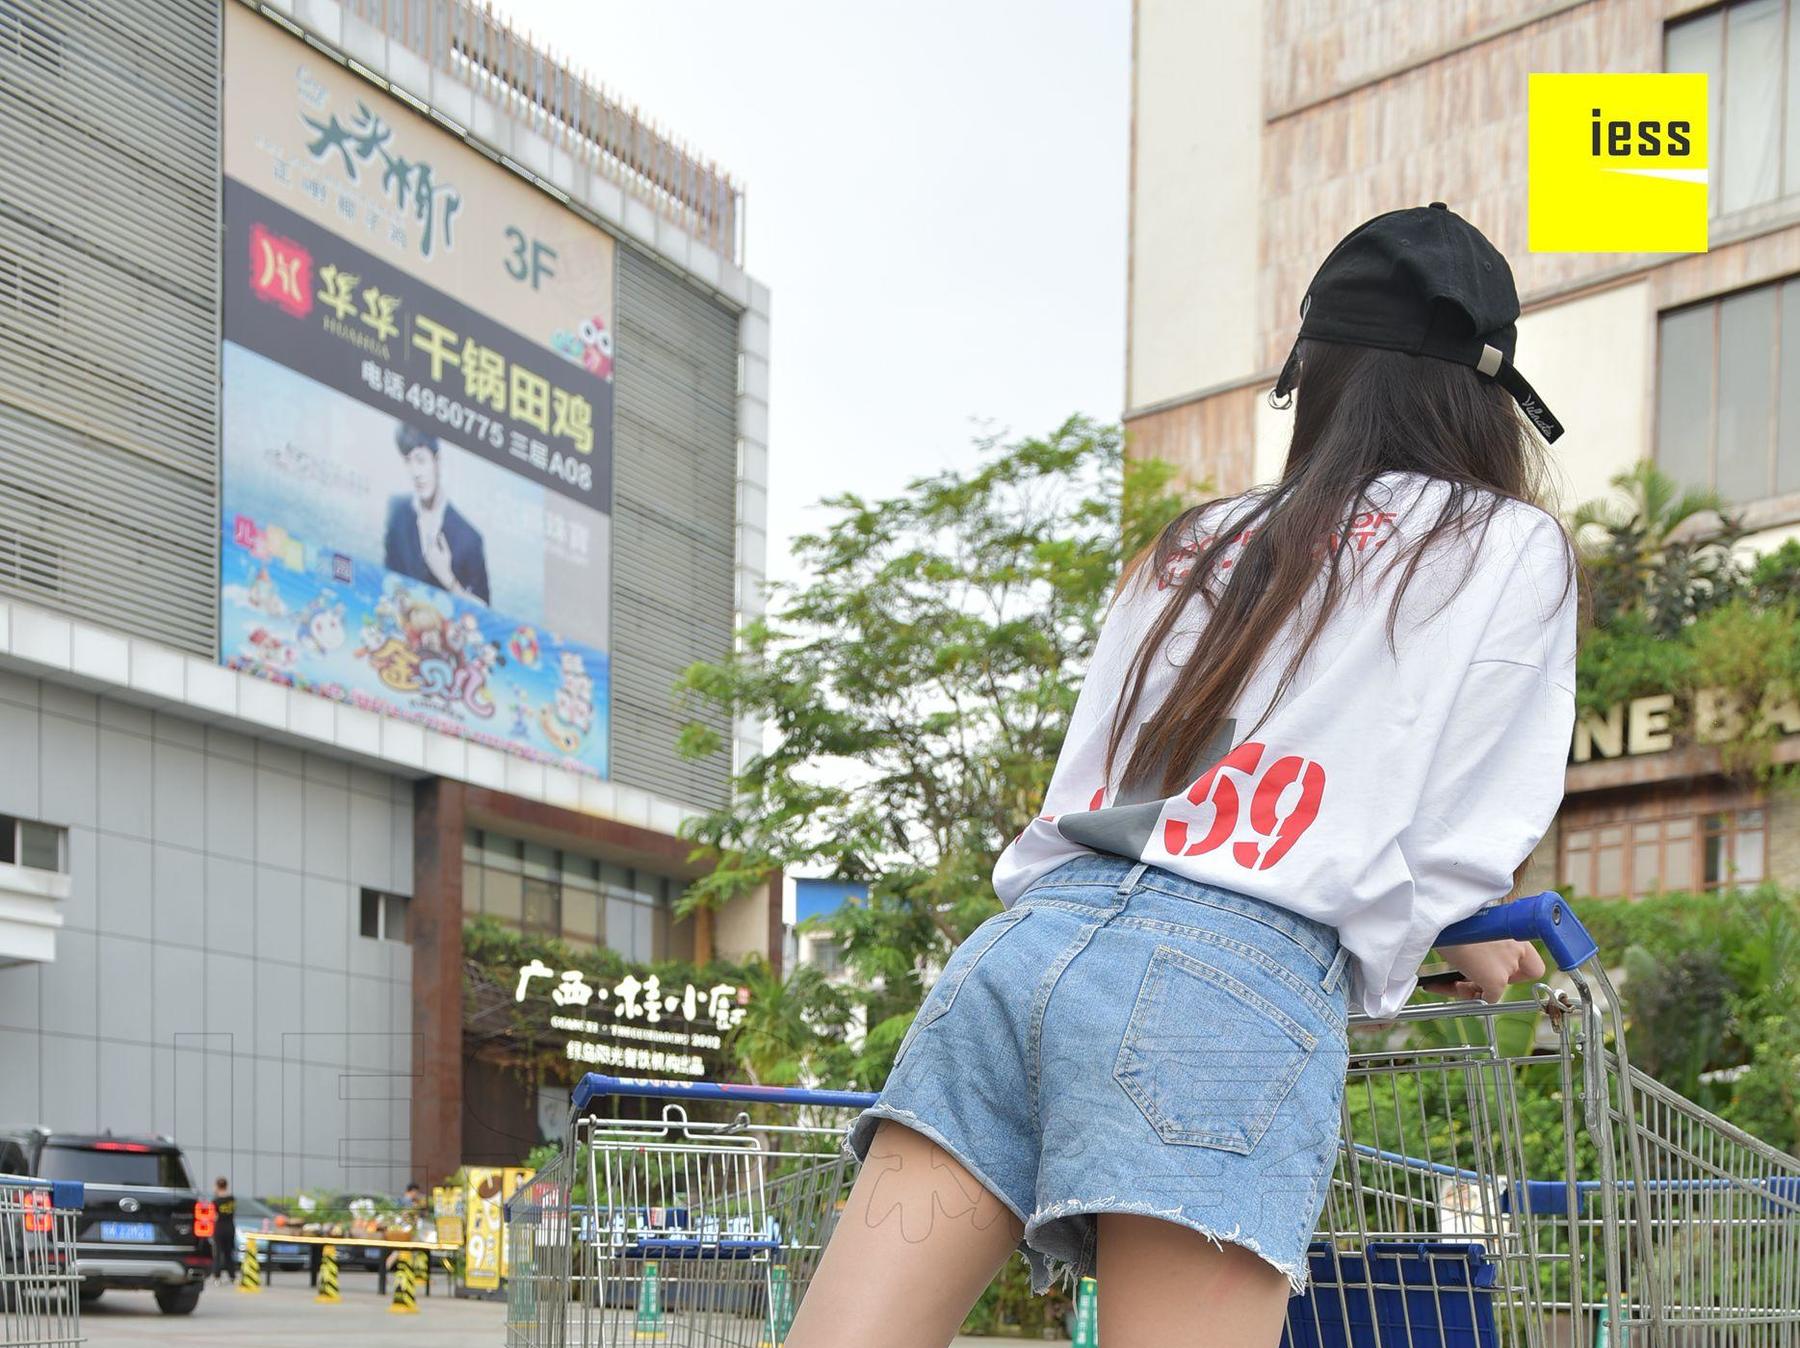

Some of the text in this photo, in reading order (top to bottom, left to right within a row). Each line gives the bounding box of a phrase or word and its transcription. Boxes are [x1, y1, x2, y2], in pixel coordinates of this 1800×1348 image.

[503, 225, 557, 290] 3F
[412, 314, 595, 454] 干锅田鸡
[1351, 512, 1398, 529] OF
[1163, 742, 1326, 871] 59
